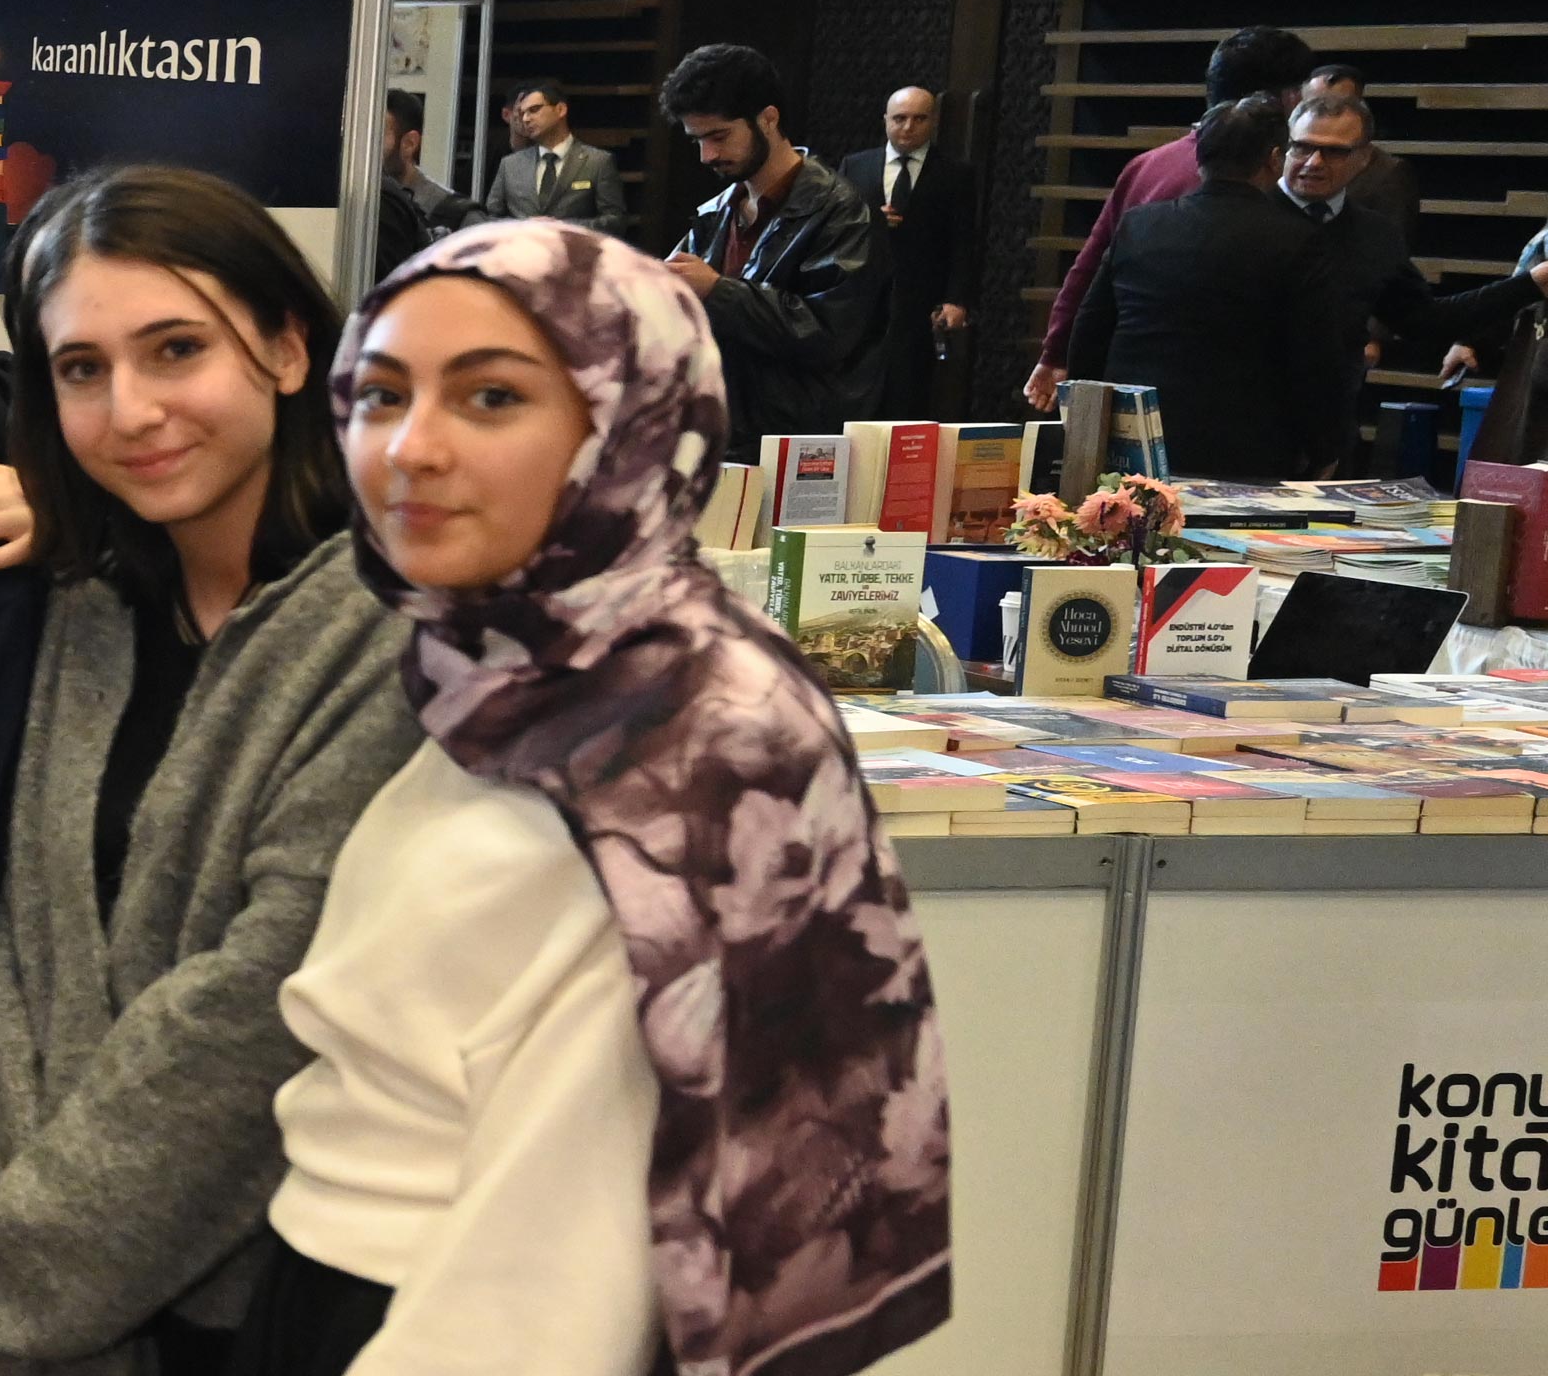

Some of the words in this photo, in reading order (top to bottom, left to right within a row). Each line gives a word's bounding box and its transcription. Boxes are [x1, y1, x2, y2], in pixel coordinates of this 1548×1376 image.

[30, 26, 262, 86] karanlıktasın
[819, 573, 849, 585] YATIR,
[885, 573, 914, 584] TEKKE
[831, 589, 899, 601] ZAVİYELERİMİZ
[1064, 607, 1096, 621] Hoca
[1060, 620, 1102, 634] Ahmed
[1169, 622, 1205, 631] ENDÜSTRİ
[1177, 634, 1205, 642] TOPLUM
